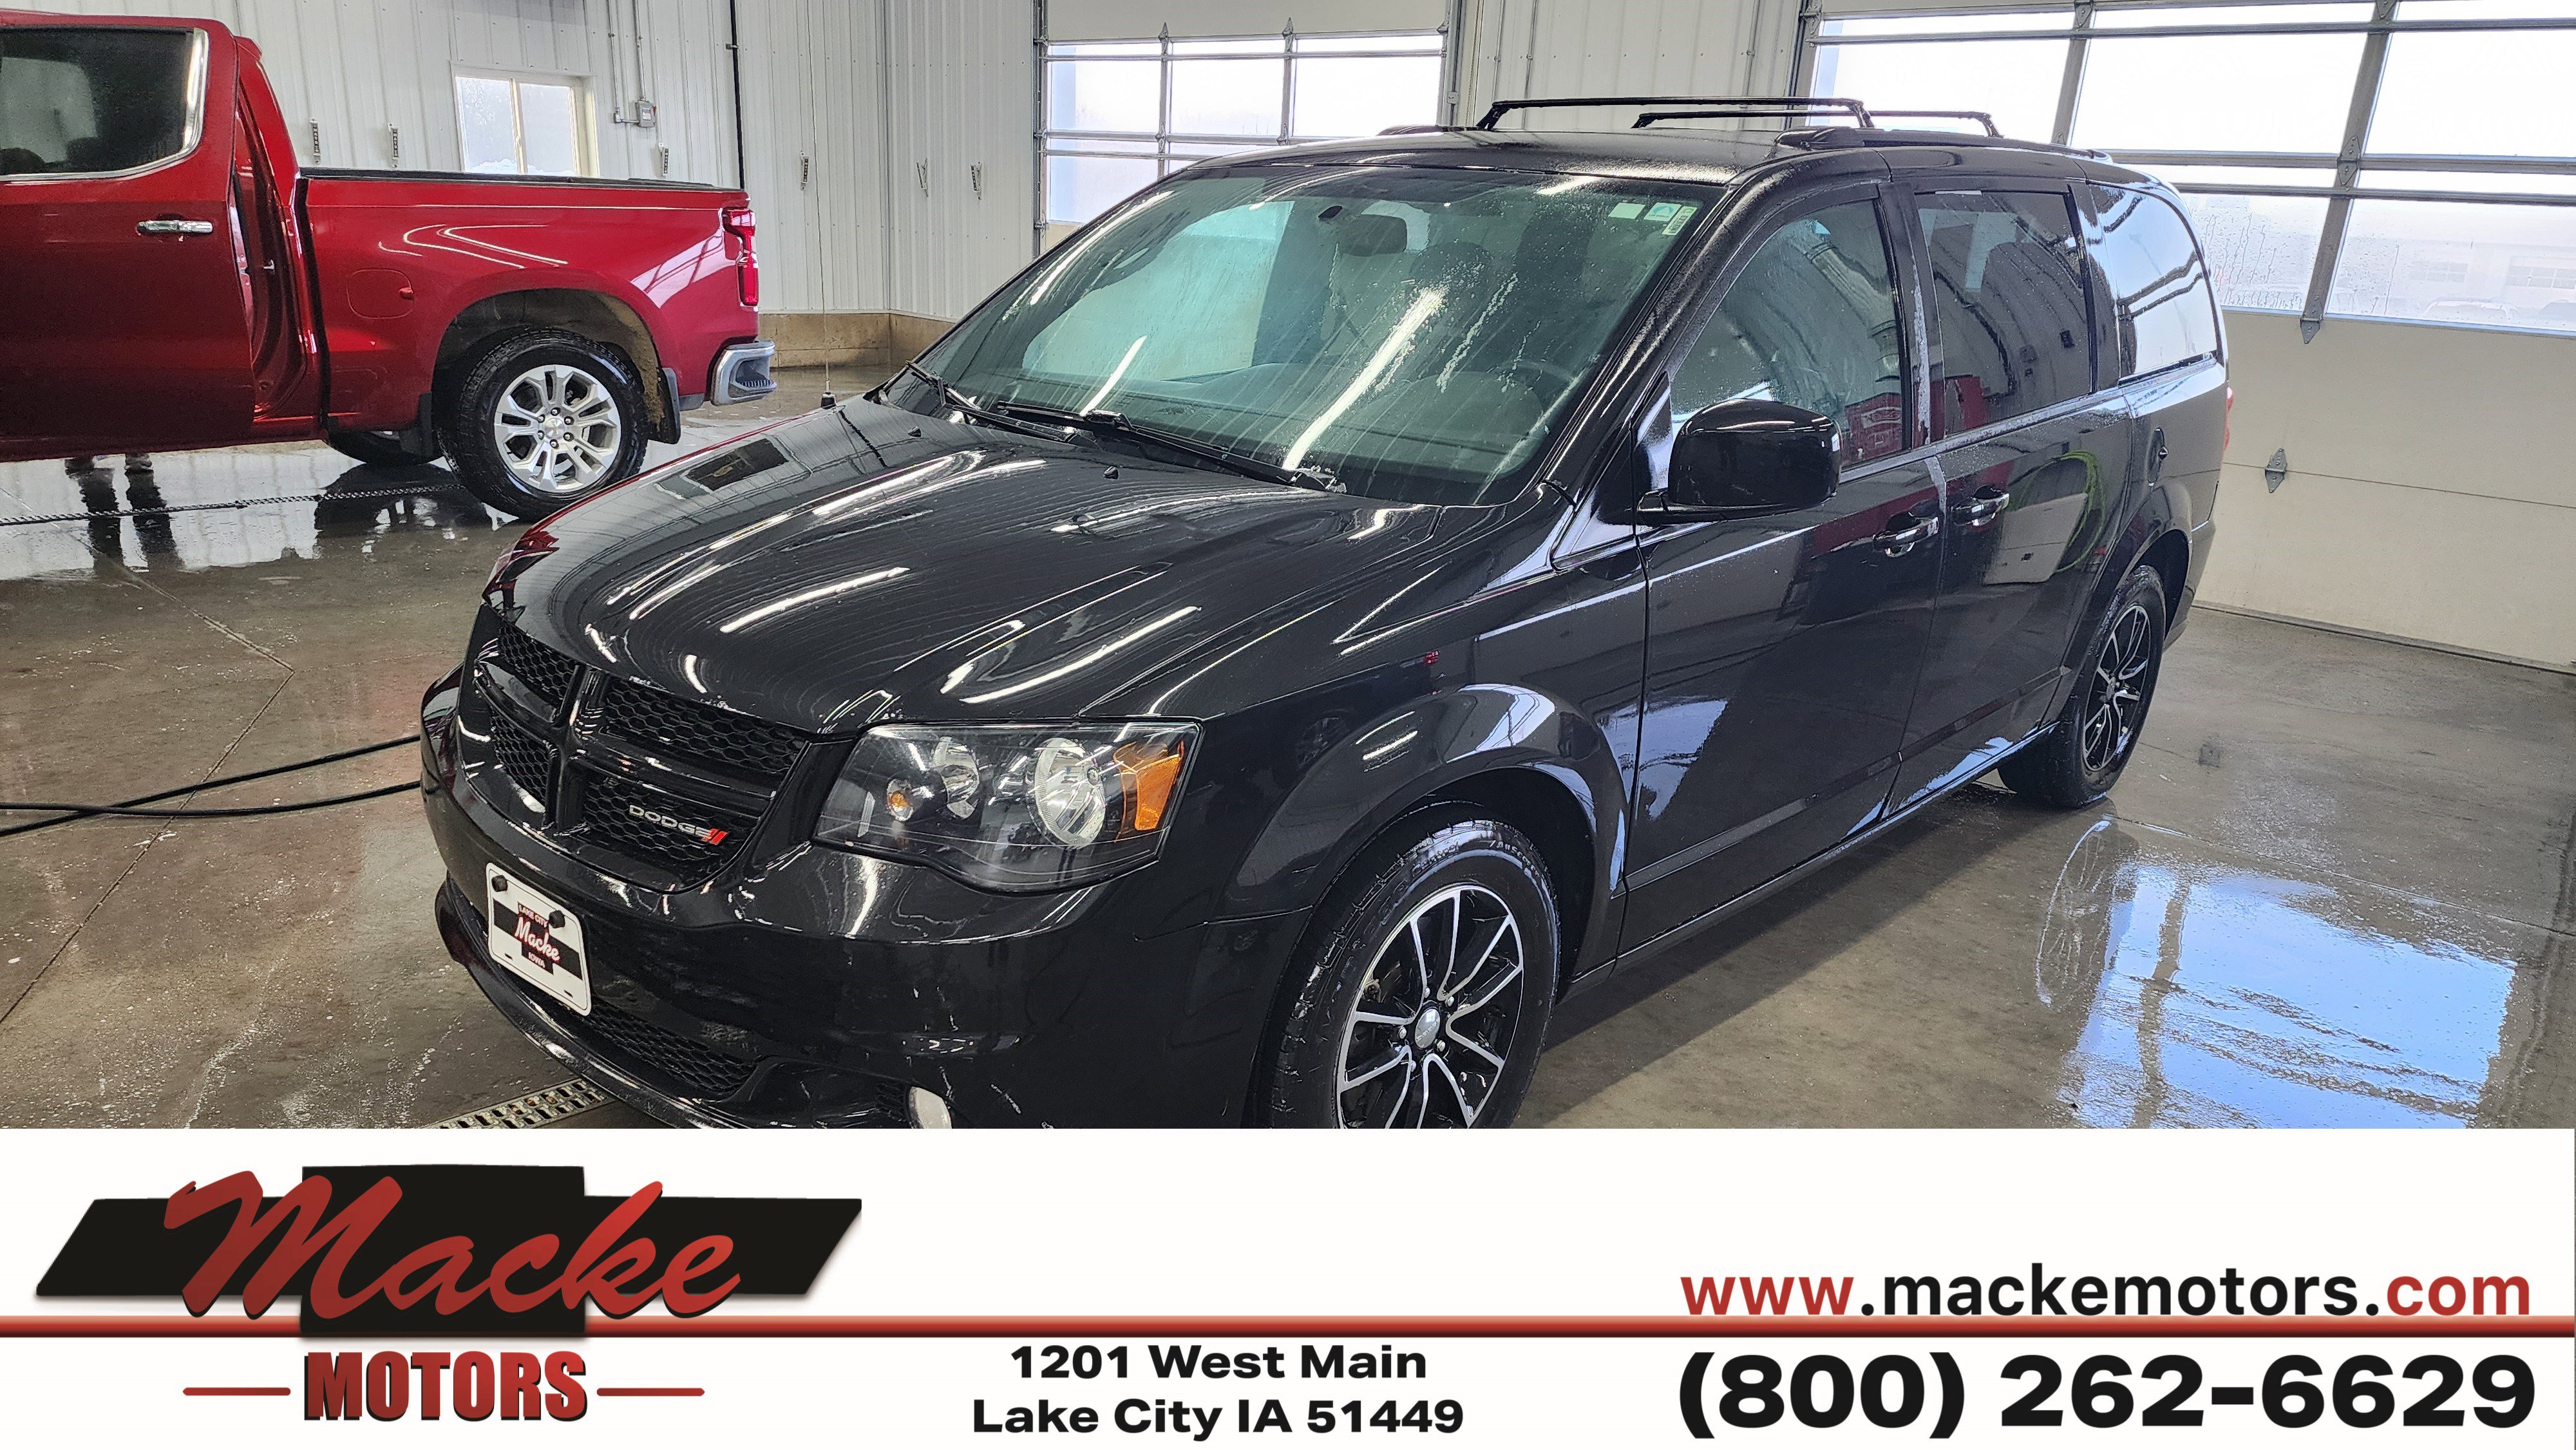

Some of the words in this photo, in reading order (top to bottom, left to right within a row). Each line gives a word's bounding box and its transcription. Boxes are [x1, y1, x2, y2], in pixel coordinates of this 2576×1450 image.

[629, 805, 712, 839] DODGE
[518, 904, 535, 920] LAKE
[535, 914, 549, 928] CITY
[515, 916, 560, 961] Macke
[528, 952, 545, 968] IOWA
